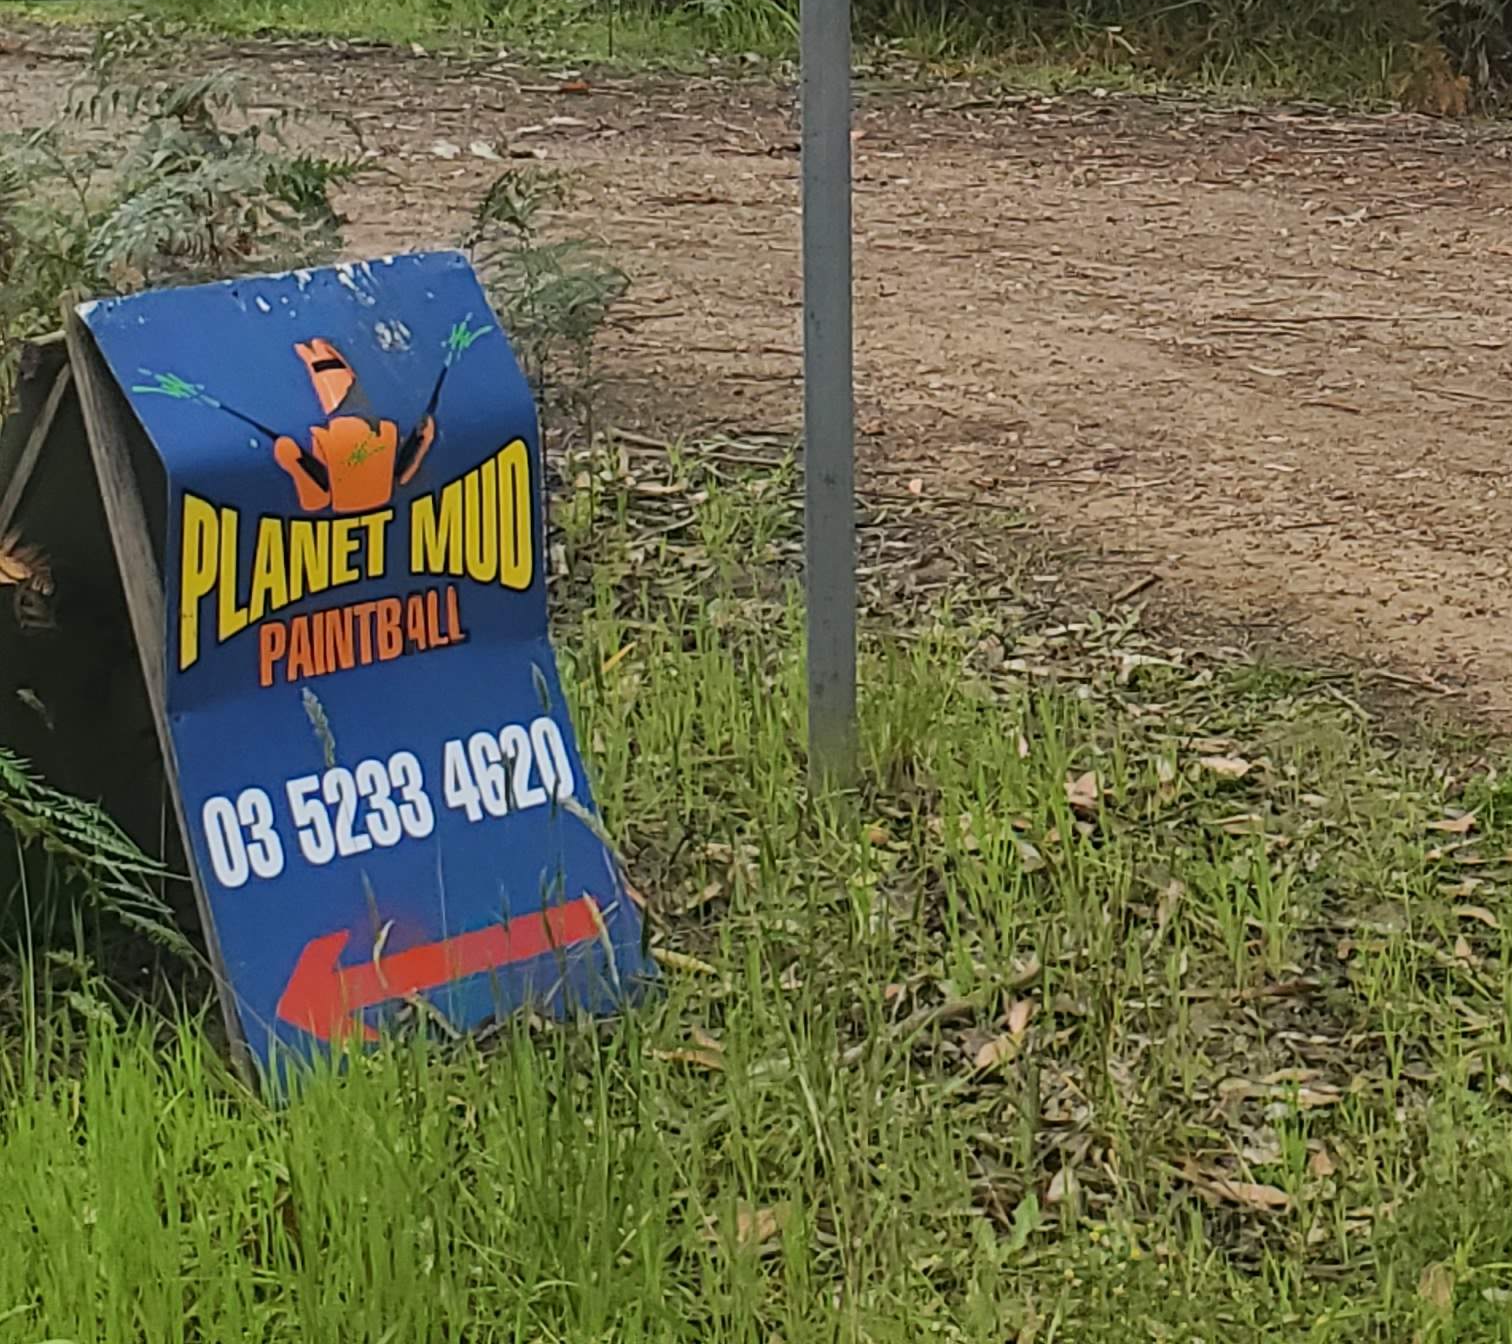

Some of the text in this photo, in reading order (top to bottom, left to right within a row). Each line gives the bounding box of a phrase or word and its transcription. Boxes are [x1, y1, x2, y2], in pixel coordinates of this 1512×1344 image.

[179, 438, 534, 672] PLANET MUD
[258, 585, 467, 688] PAINTBALL
[203, 716, 574, 889] 03 5233 4620
